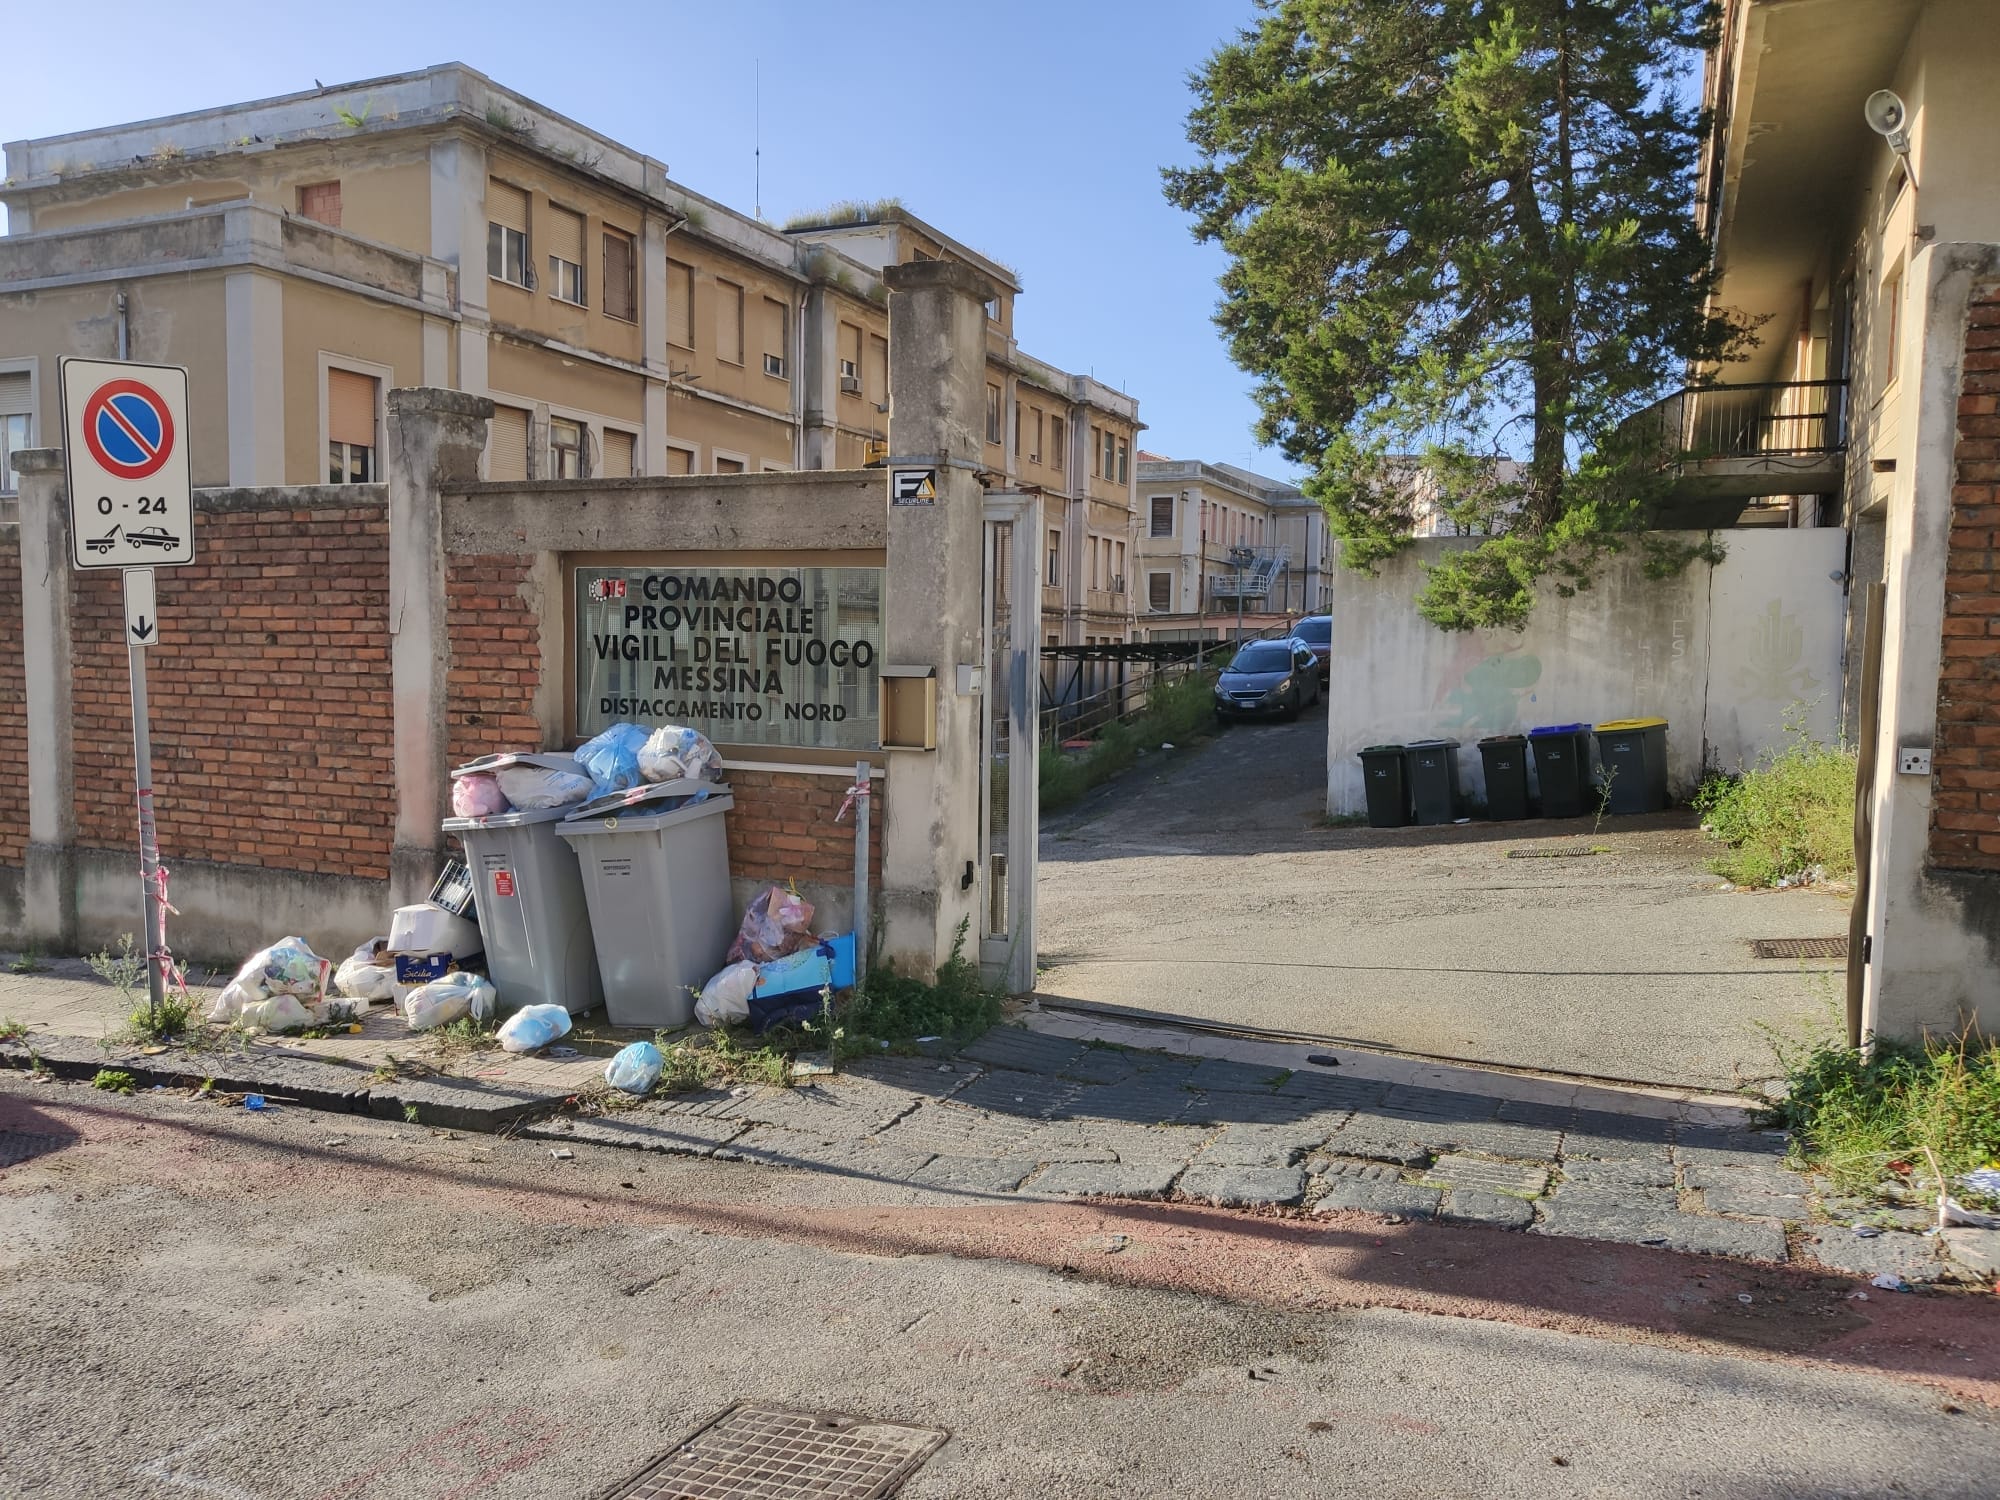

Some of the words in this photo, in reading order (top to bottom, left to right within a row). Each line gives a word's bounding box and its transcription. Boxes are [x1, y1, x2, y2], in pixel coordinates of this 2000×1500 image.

[97, 496, 112, 514] 0
[137, 496, 167, 514] 24
[643, 576, 802, 603] COMANDO
[625, 605, 813, 634] PROVINCIALE
[594, 634, 675, 662] VIGILI
[693, 636, 750, 664] DEL
[766, 638, 873, 668] FUOCO
[653, 666, 784, 695] MESSINA
[600, 698, 763, 721] DISTACCAMENTO
[784, 703, 847, 722] NORD
